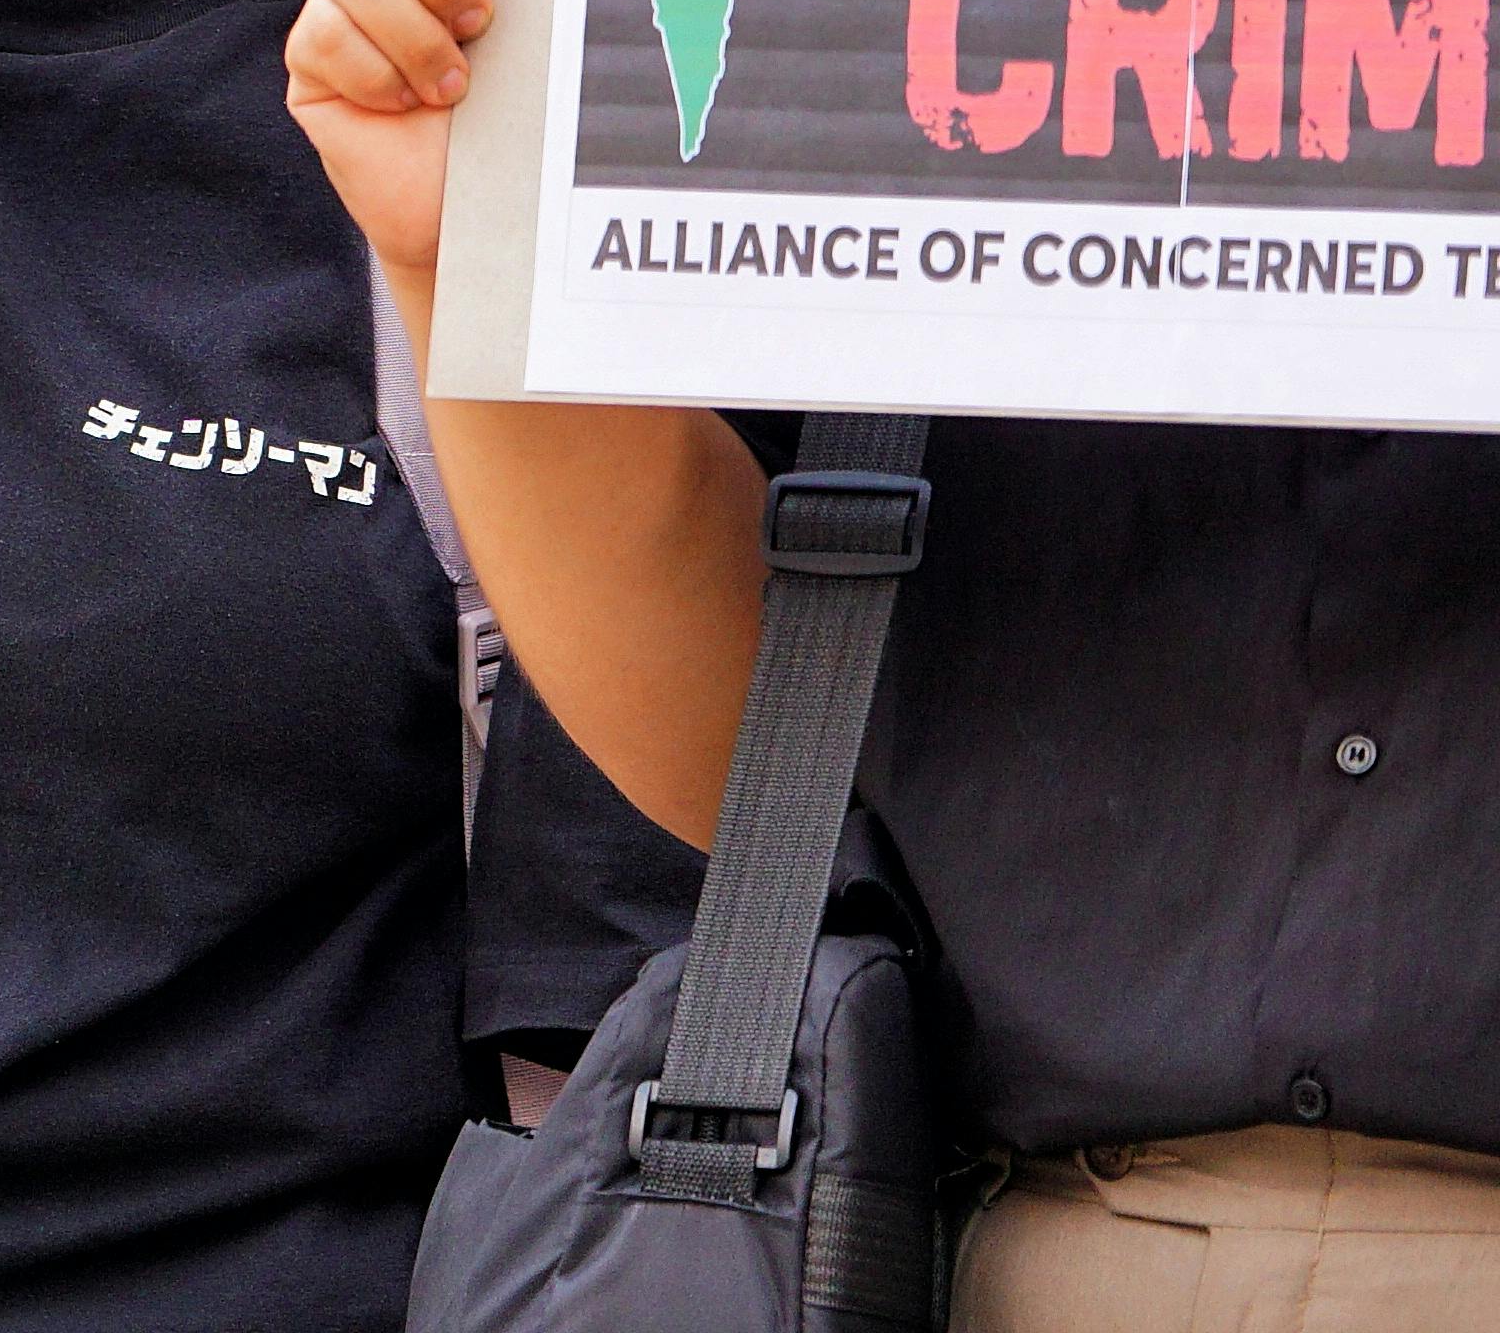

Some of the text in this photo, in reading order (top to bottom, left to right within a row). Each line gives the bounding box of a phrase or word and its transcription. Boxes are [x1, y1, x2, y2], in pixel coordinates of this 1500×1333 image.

[591, 218, 899, 283] ALLIANCE
[918, 229, 1006, 287] OF
[1021, 233, 1424, 297] CONCERNED
[82, 399, 377, 506] チェンソーマン
